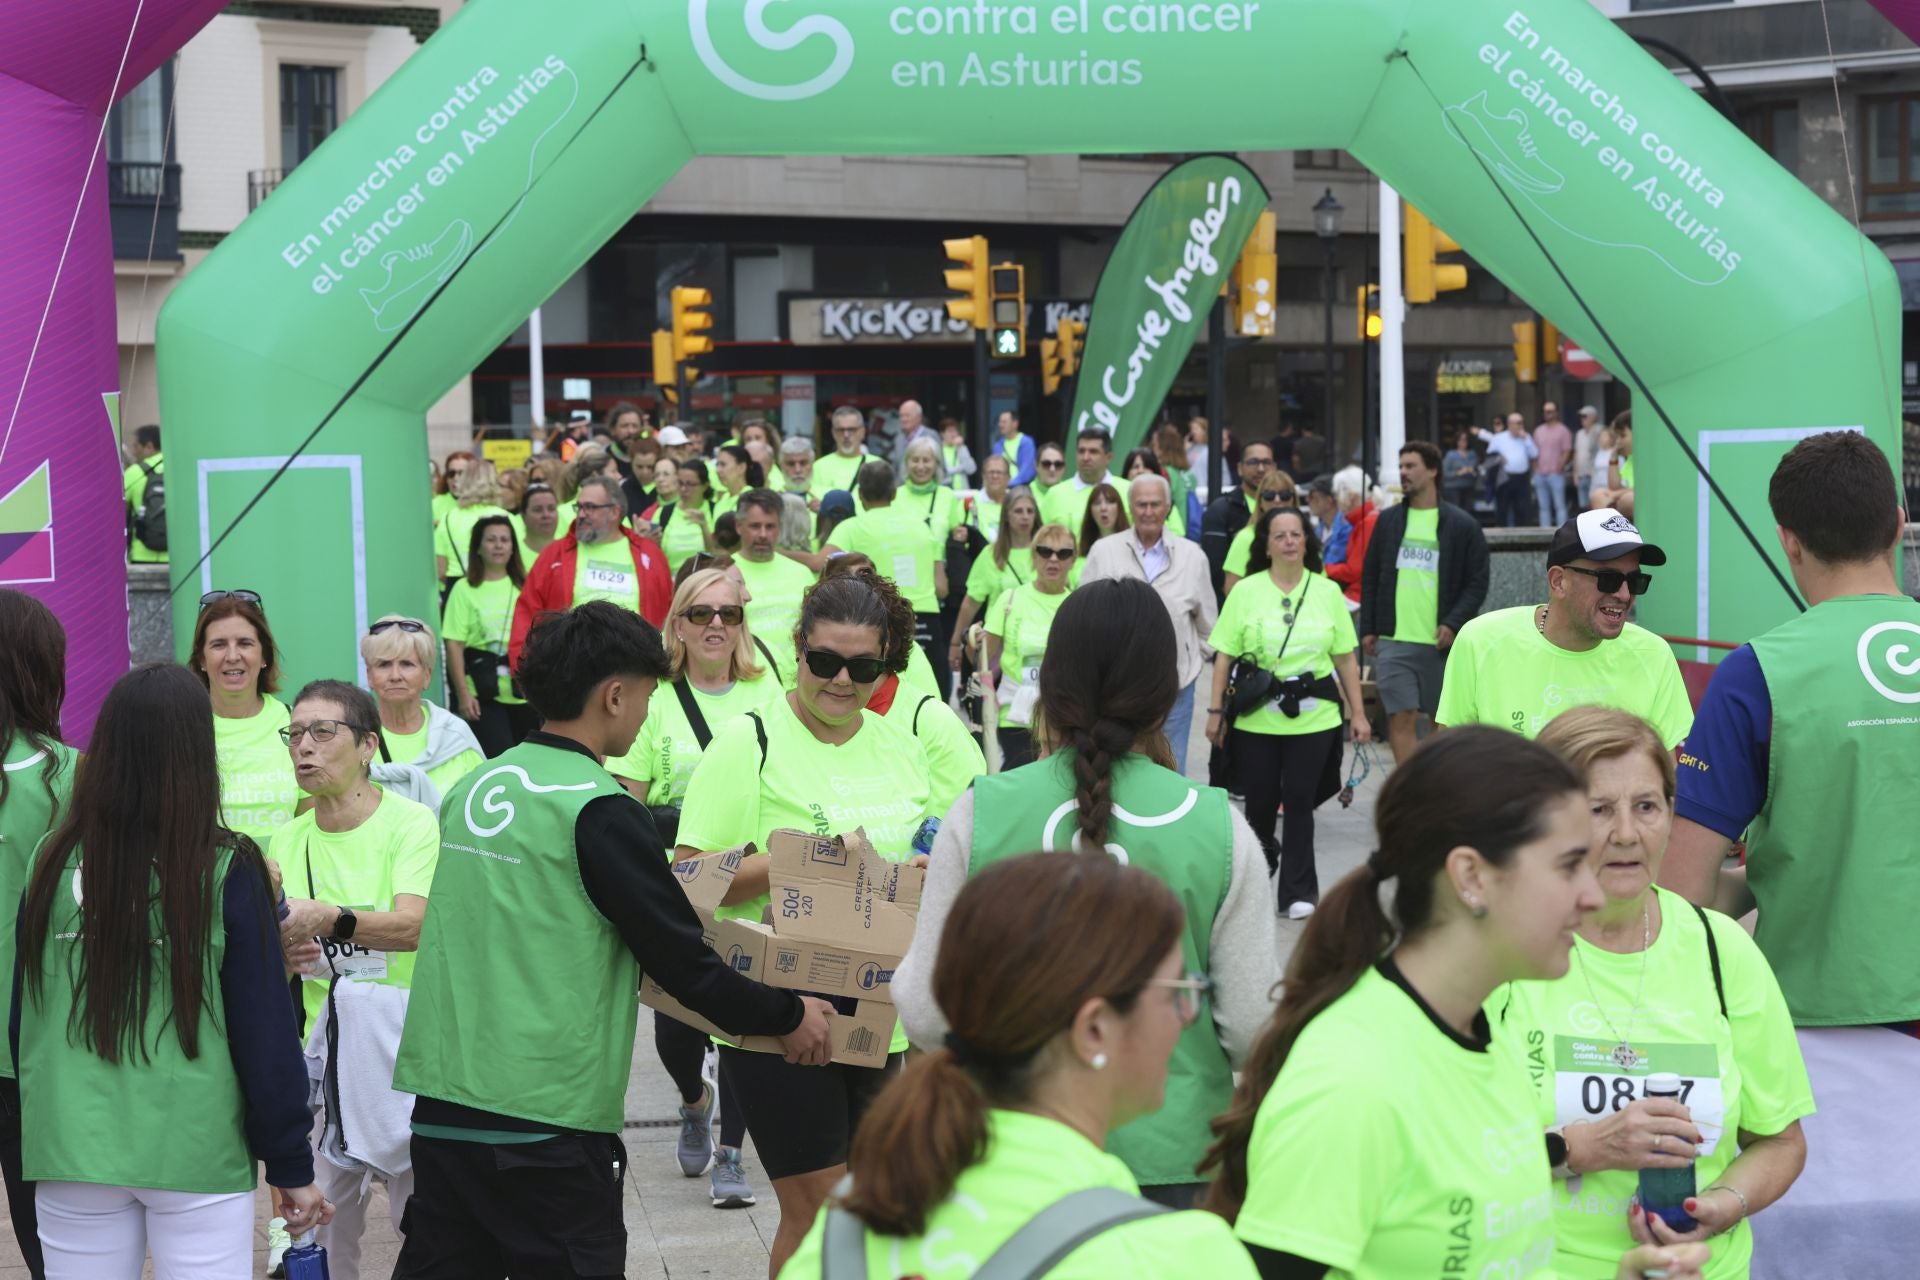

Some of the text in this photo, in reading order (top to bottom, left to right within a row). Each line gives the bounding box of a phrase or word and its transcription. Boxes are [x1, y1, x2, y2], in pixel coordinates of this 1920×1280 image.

[889, 0, 1037, 35] contra
[1050, 0, 1088, 33] el
[891, 50, 1143, 87] en Asturias
[1503, 10, 1725, 209] En marcha contra
[281, 65, 499, 268] En marcha contra
[312, 54, 566, 294] el cáncer en Asturias
[1478, 43, 1741, 272] el cáncer en Asturias
[1102, 310, 1172, 408] Corte
[1145, 176, 1241, 323] Inglés
[592, 570, 625, 583] 1629
[809, 803, 831, 837] RIAS
[783, 888, 800, 920] 50cl
[802, 896, 813, 917] x20
[855, 862, 865, 911] CREEMO
[864, 898, 872, 928] CADA
[1527, 1029, 1546, 1091] RIAS
[1581, 1075, 1695, 1115] 087
